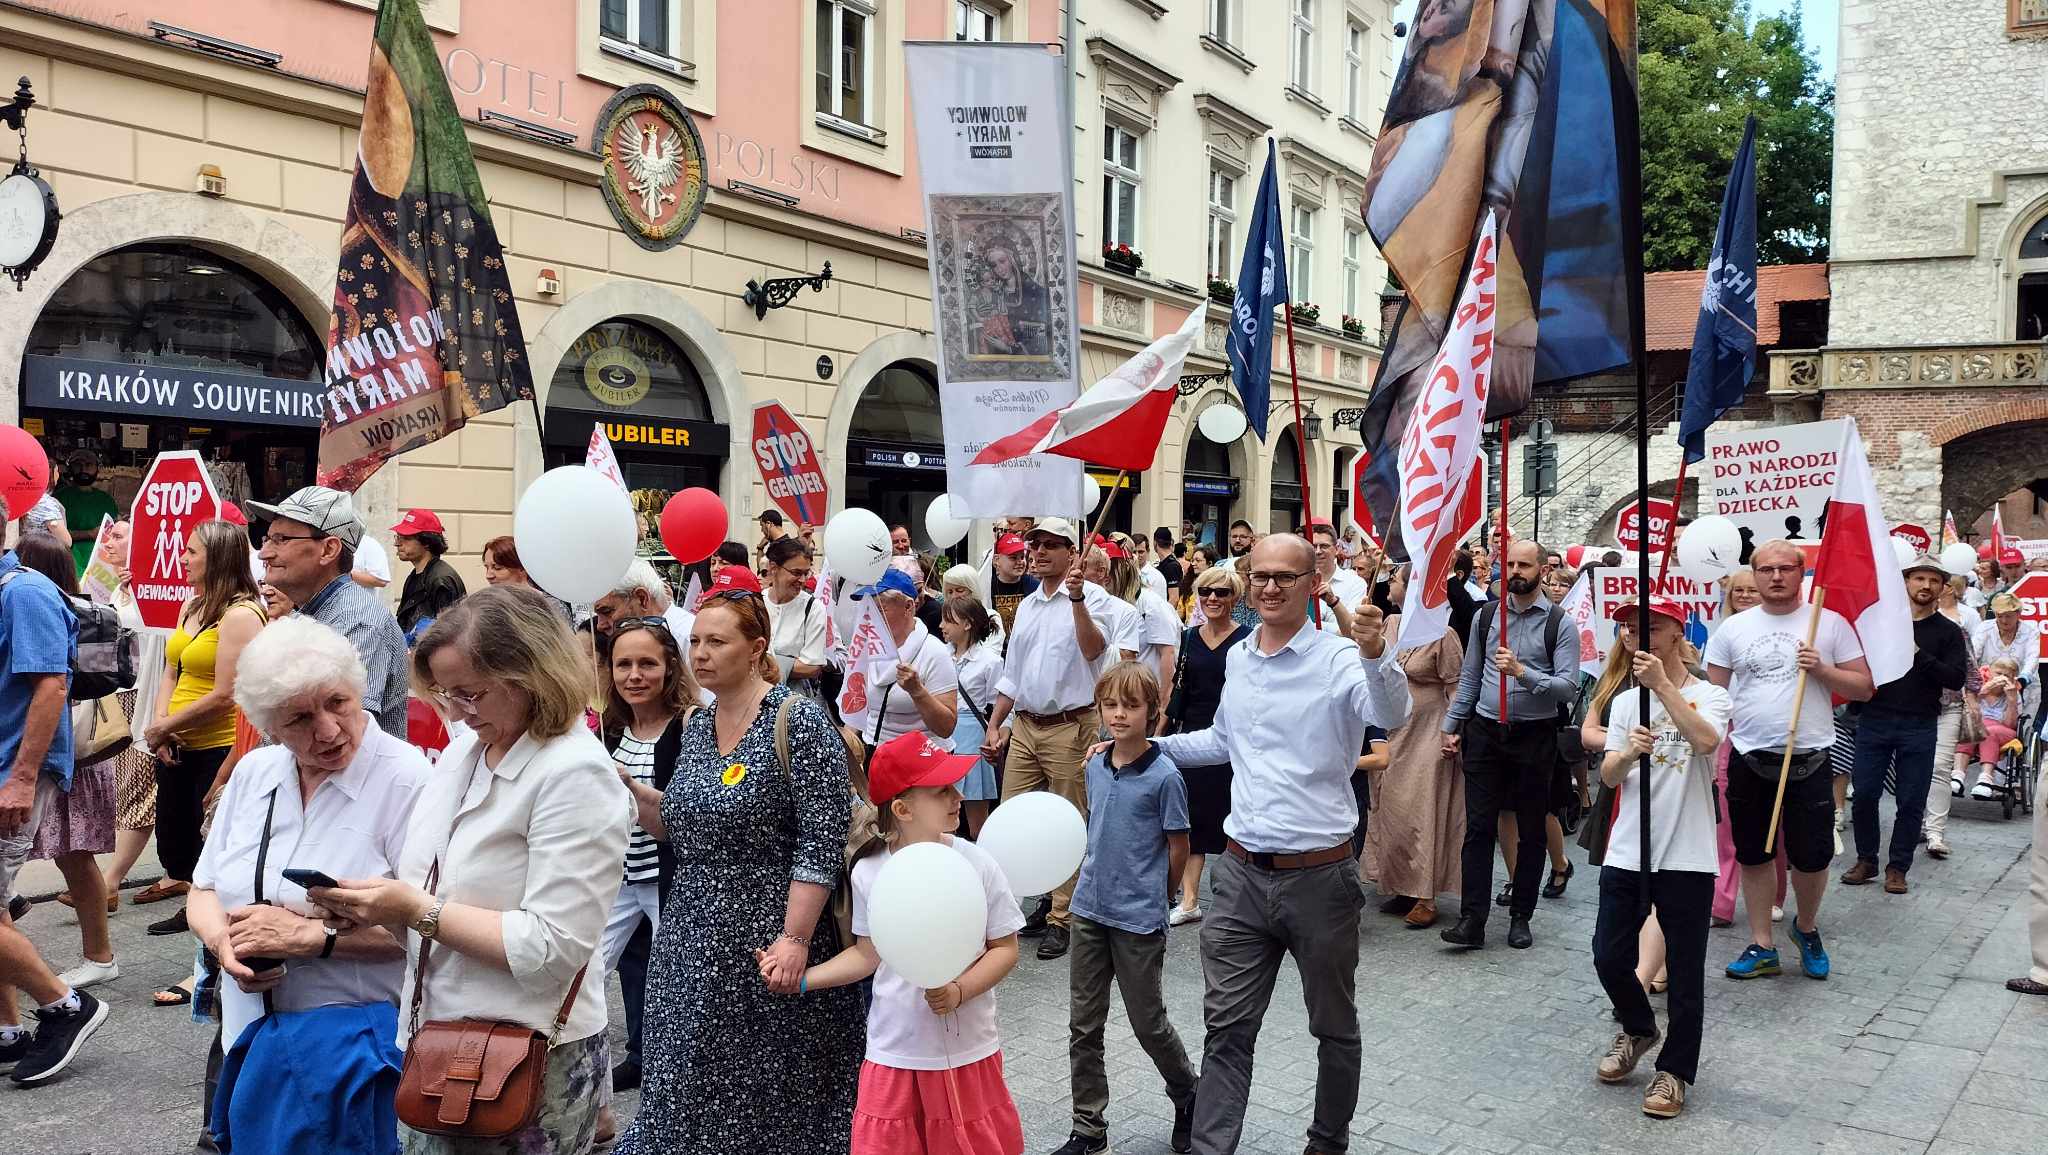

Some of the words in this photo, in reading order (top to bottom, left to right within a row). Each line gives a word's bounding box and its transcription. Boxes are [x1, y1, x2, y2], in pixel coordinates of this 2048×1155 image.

[446, 48, 579, 127] OTEL
[713, 131, 841, 202] POLSKI
[59, 370, 179, 406] KRAKÓW
[193, 382, 324, 419] SOUVENIRS
[594, 383, 641, 400] JUBILER
[755, 431, 808, 471] STOP
[872, 453, 897, 462] POLISH
[1712, 439, 1780, 460] PRAWO
[1714, 463, 1742, 479] DO
[1749, 452, 1837, 475] NARODZI
[768, 471, 825, 498] GENDER
[1716, 487, 1738, 497] DLA
[145, 482, 202, 516] STOP
[1718, 495, 1799, 515] DZIECKA
